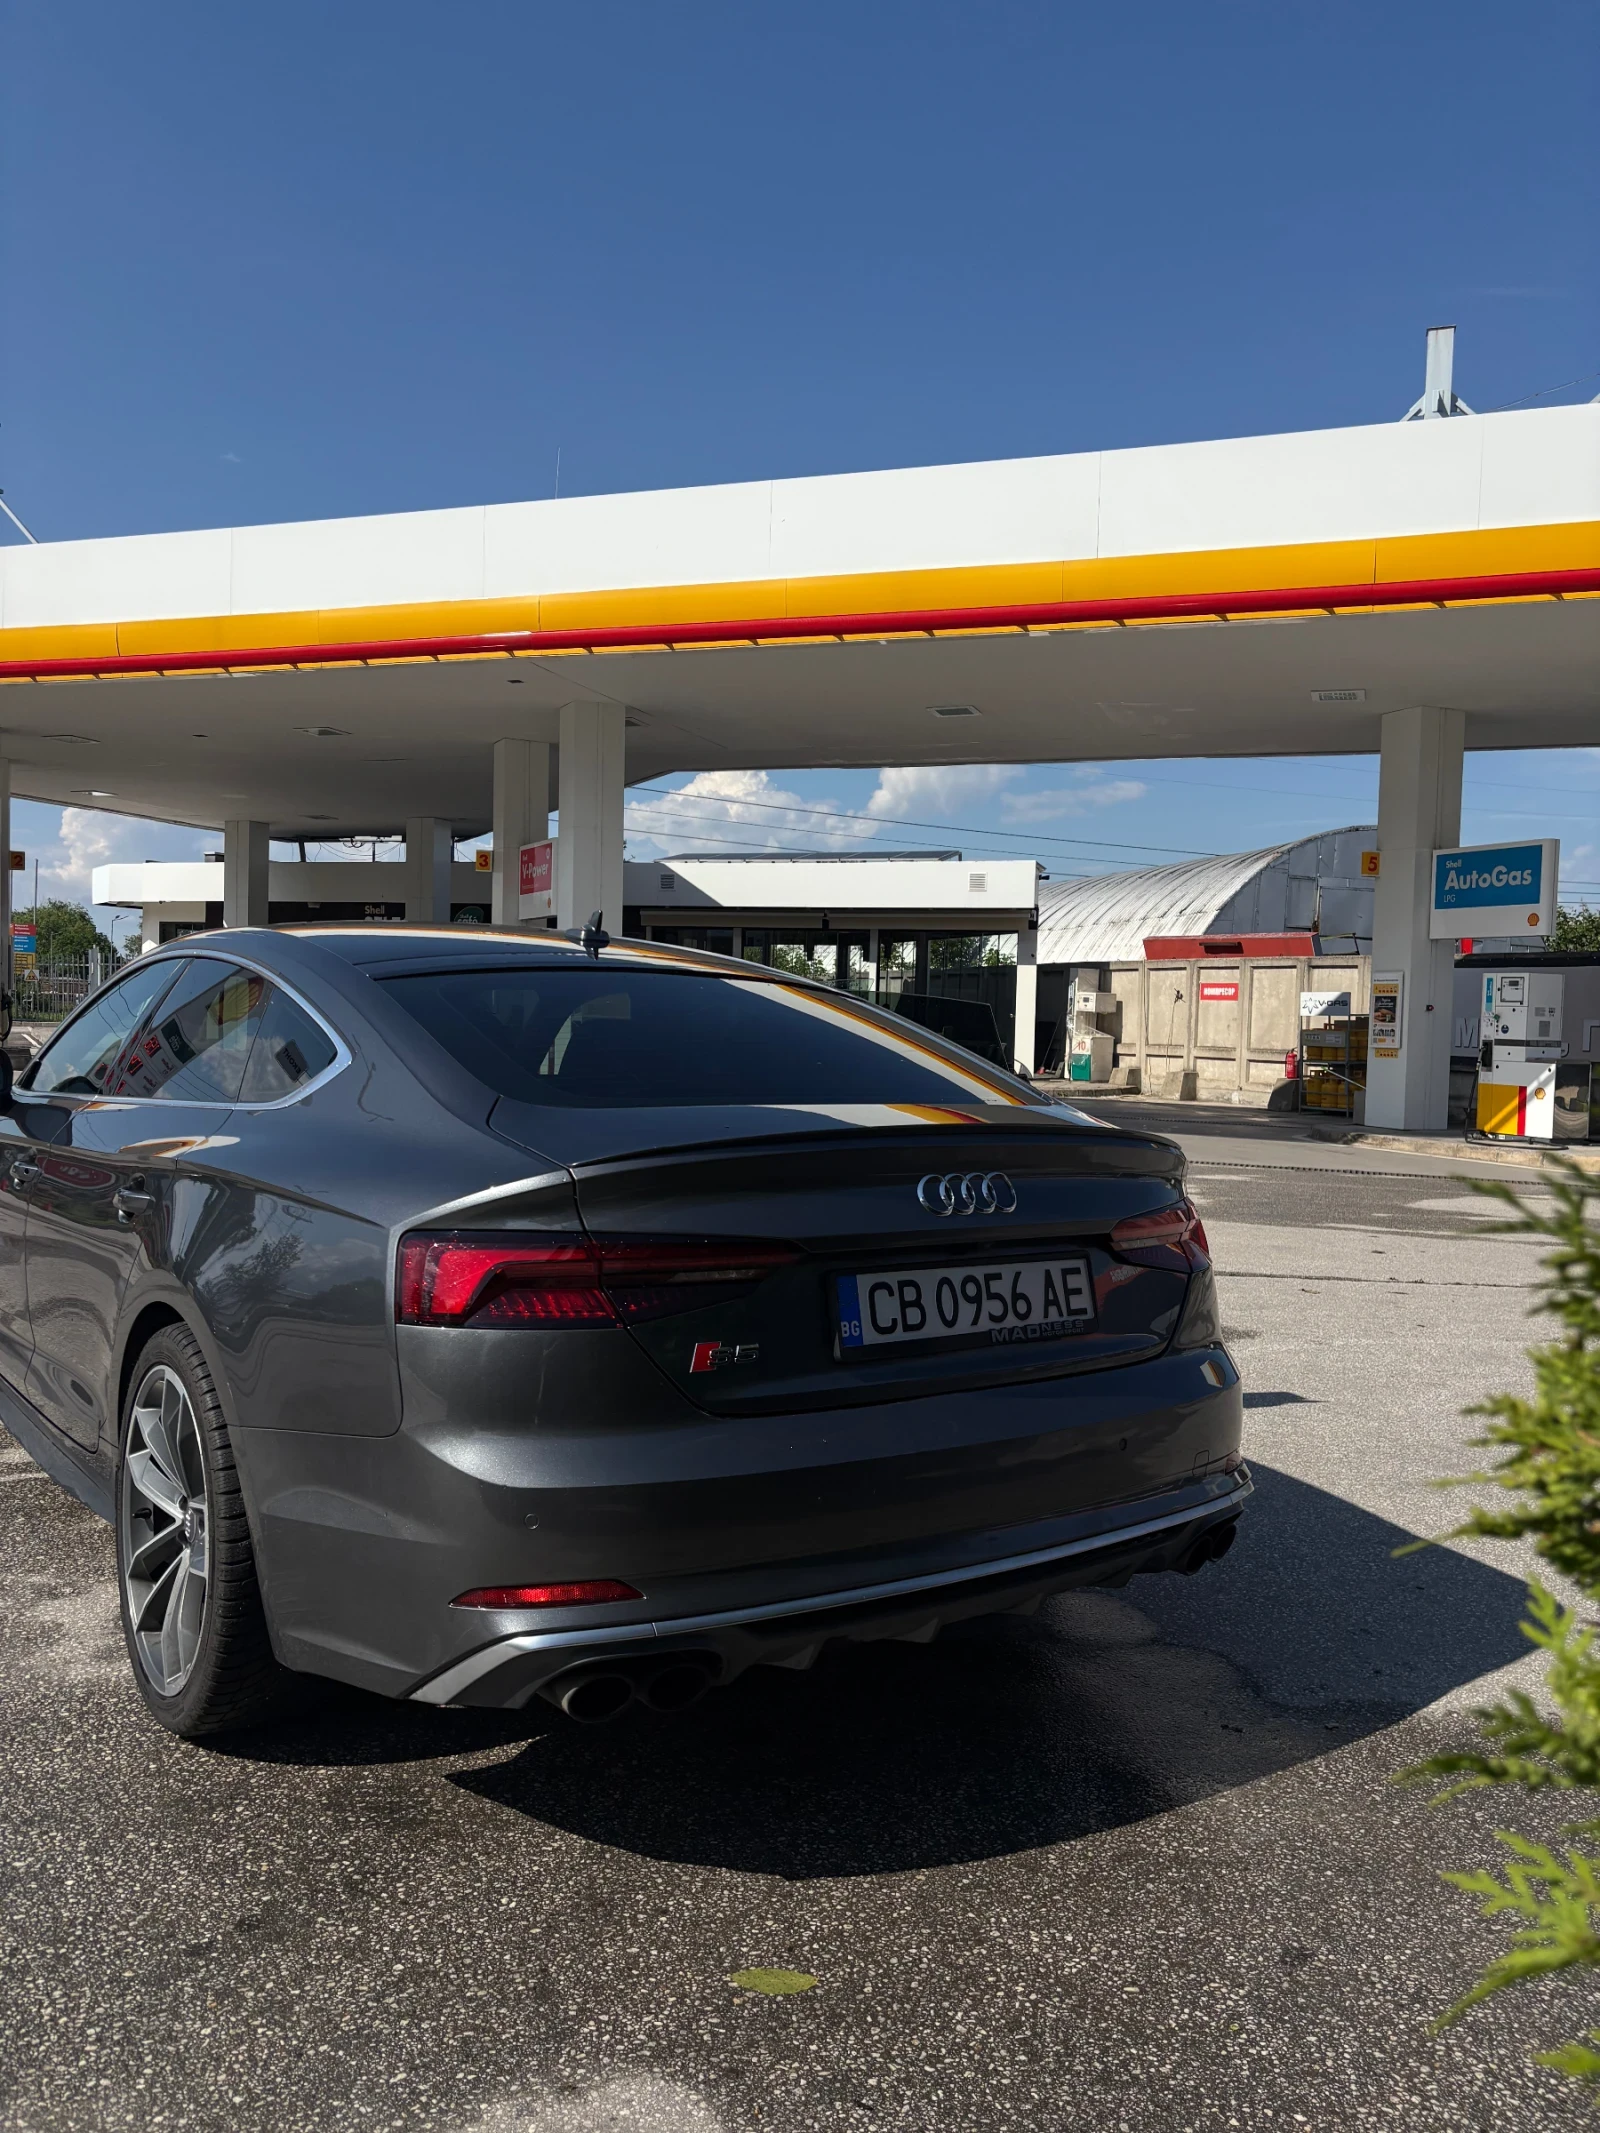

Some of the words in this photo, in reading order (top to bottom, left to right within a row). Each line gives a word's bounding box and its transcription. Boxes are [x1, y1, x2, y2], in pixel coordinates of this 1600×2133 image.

[13, 854, 23, 867] 2
[478, 854, 489, 867] 3
[1367, 856, 1378, 872] 5
[1445, 859, 1462, 868] Shell
[1444, 865, 1532, 891] AutoGas
[1443, 894, 1456, 903] LPG
[364, 904, 385, 915] Shell
[868, 1278, 927, 1335] CB
[935, 1270, 1032, 1329] 0956
[1043, 1266, 1088, 1319] AE
[840, 1320, 860, 1338] BG
[991, 1318, 1084, 1344] MADNESS
[1042, 1327, 1085, 1337] MOTORSPORT
[707, 1343, 759, 1367] S5
